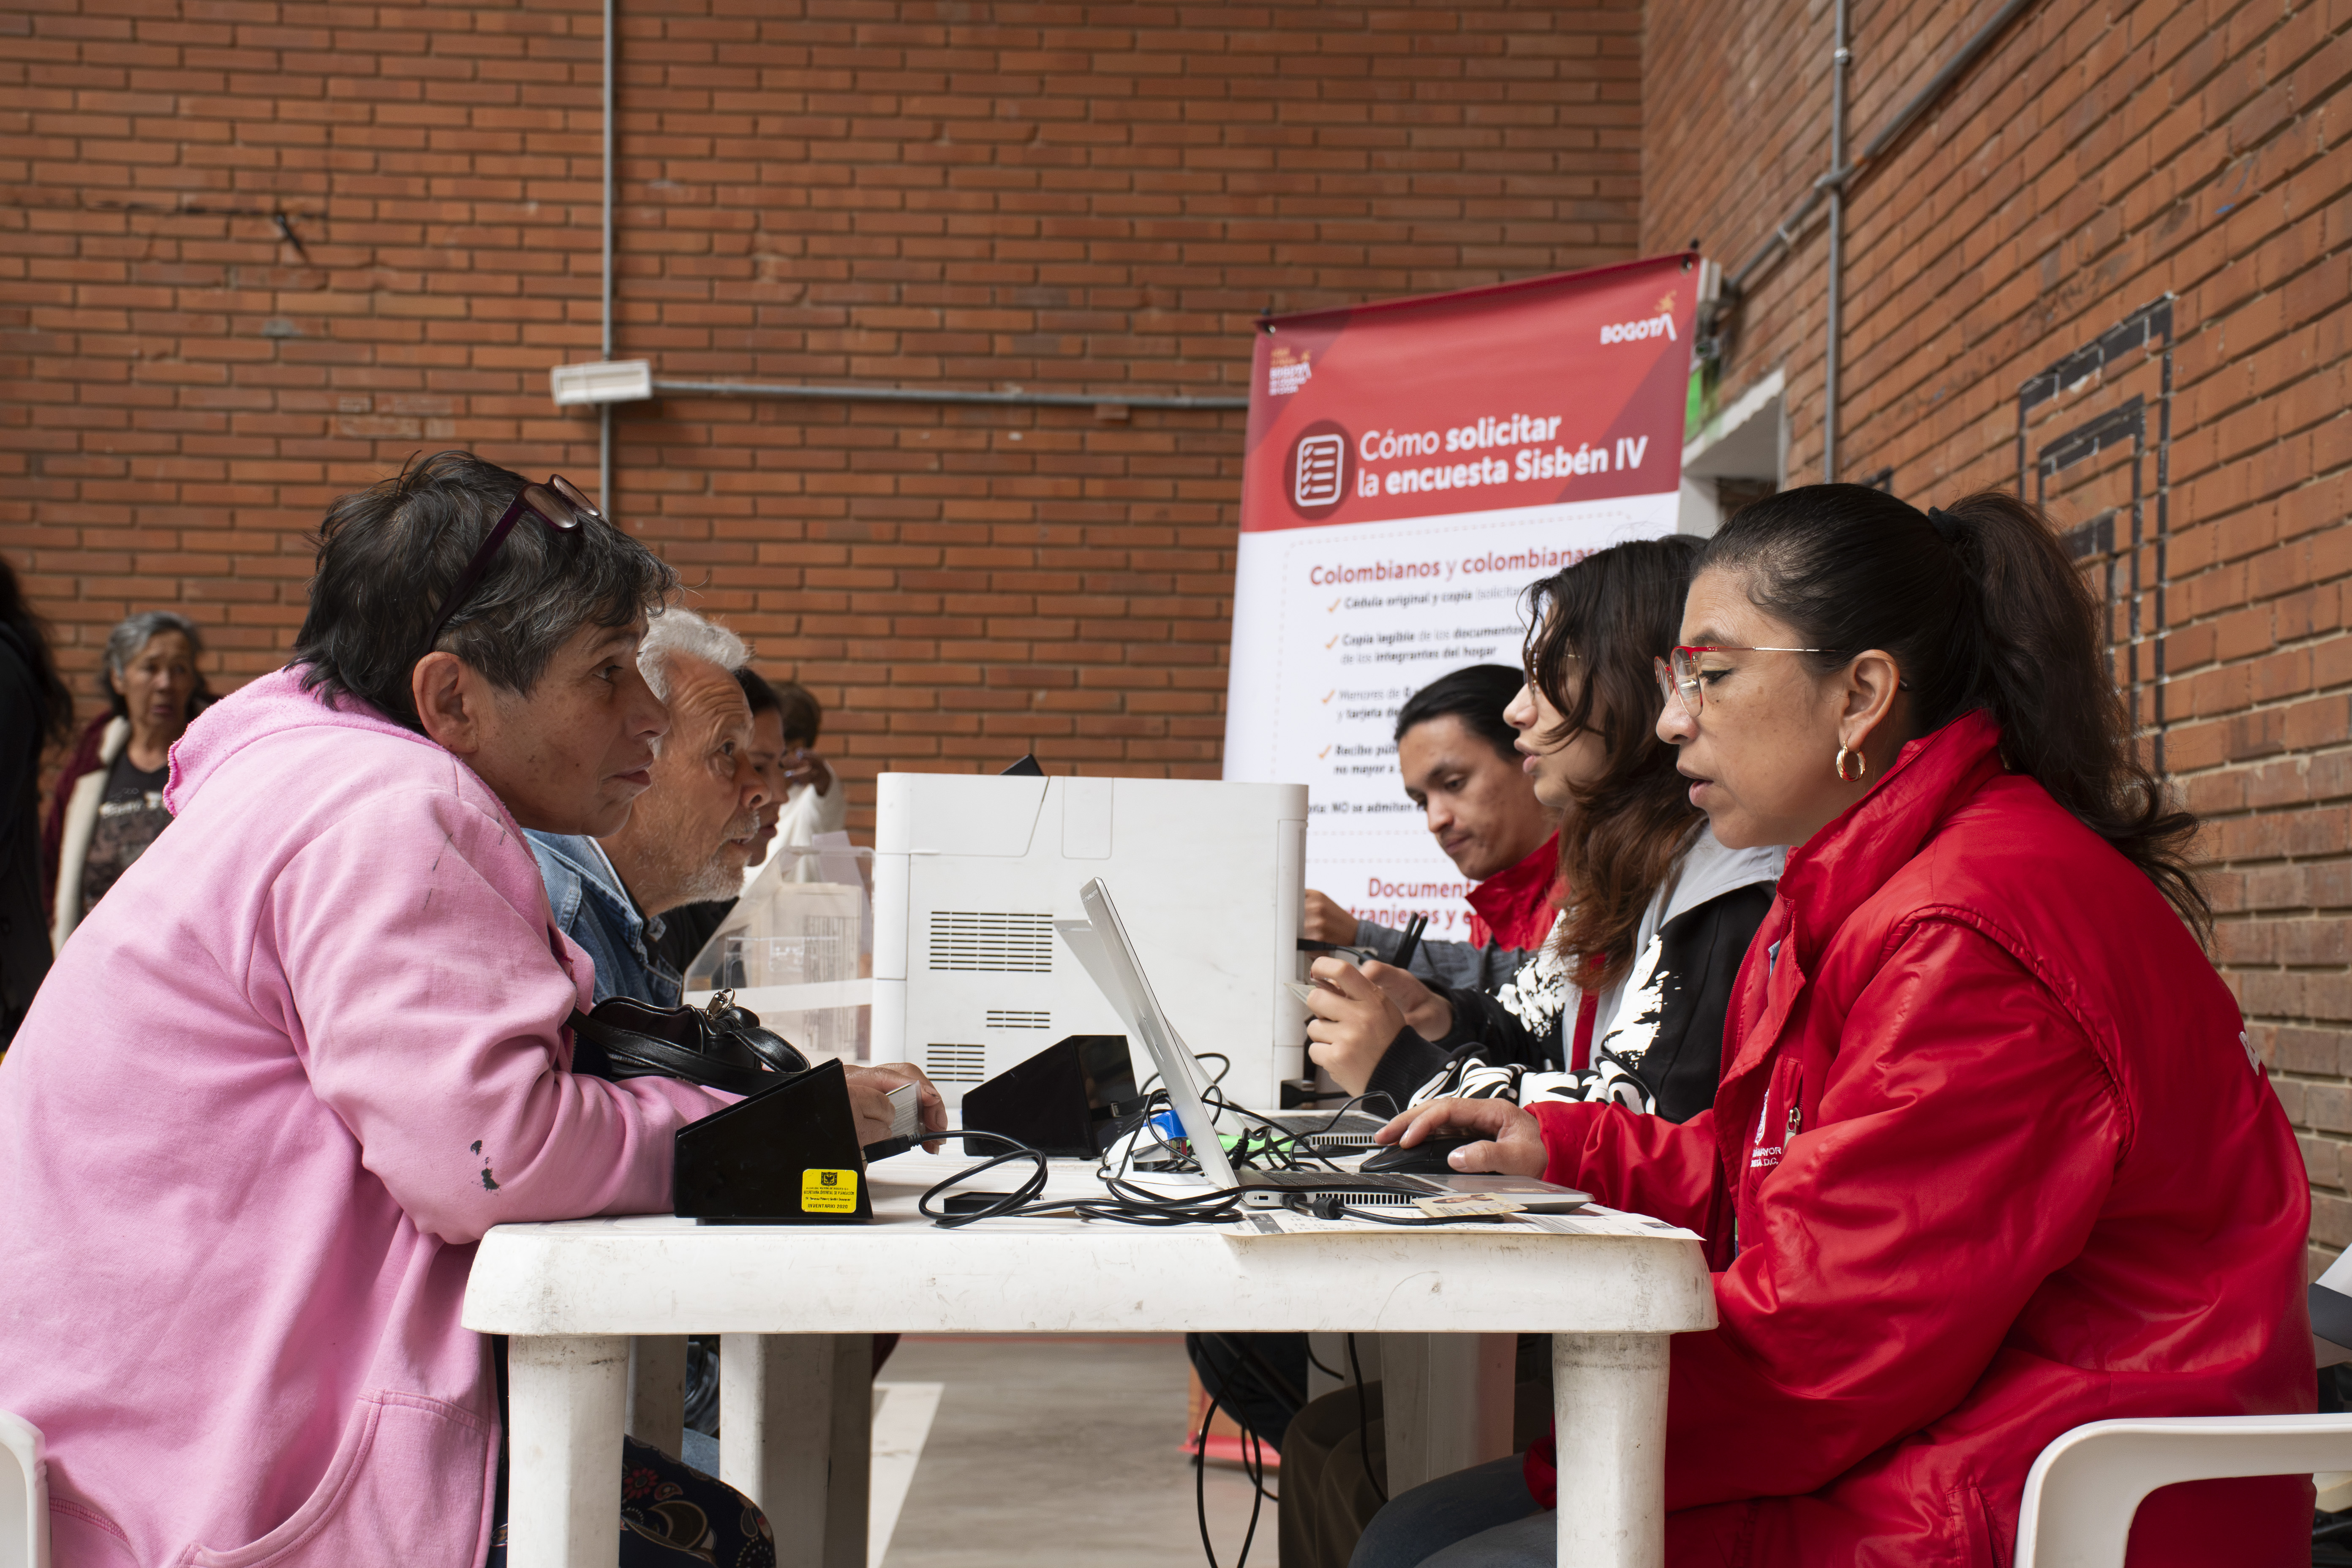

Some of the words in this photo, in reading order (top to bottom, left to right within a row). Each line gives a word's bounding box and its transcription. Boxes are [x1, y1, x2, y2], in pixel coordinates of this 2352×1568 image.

[1359, 428, 1440, 461] Cómo
[1445, 414, 1562, 452] solicitar
[1358, 467, 1380, 498] la
[1385, 455, 1509, 495] encuesta
[1514, 442, 1609, 482] Sisbén
[1615, 435, 1649, 471] IV
[1311, 559, 1440, 585] Colombianos
[1445, 560, 1457, 583] y
[1386, 593, 1429, 609] original
[1432, 594, 1439, 607] y
[1441, 589, 1472, 604] copia
[1342, 633, 1373, 651] Copia
[1377, 630, 1414, 646] legible
[1375, 649, 1439, 666] integrantes
[1442, 646, 1459, 659] del
[1462, 645, 1497, 659] hogar
[1446, 910, 1456, 930] y
